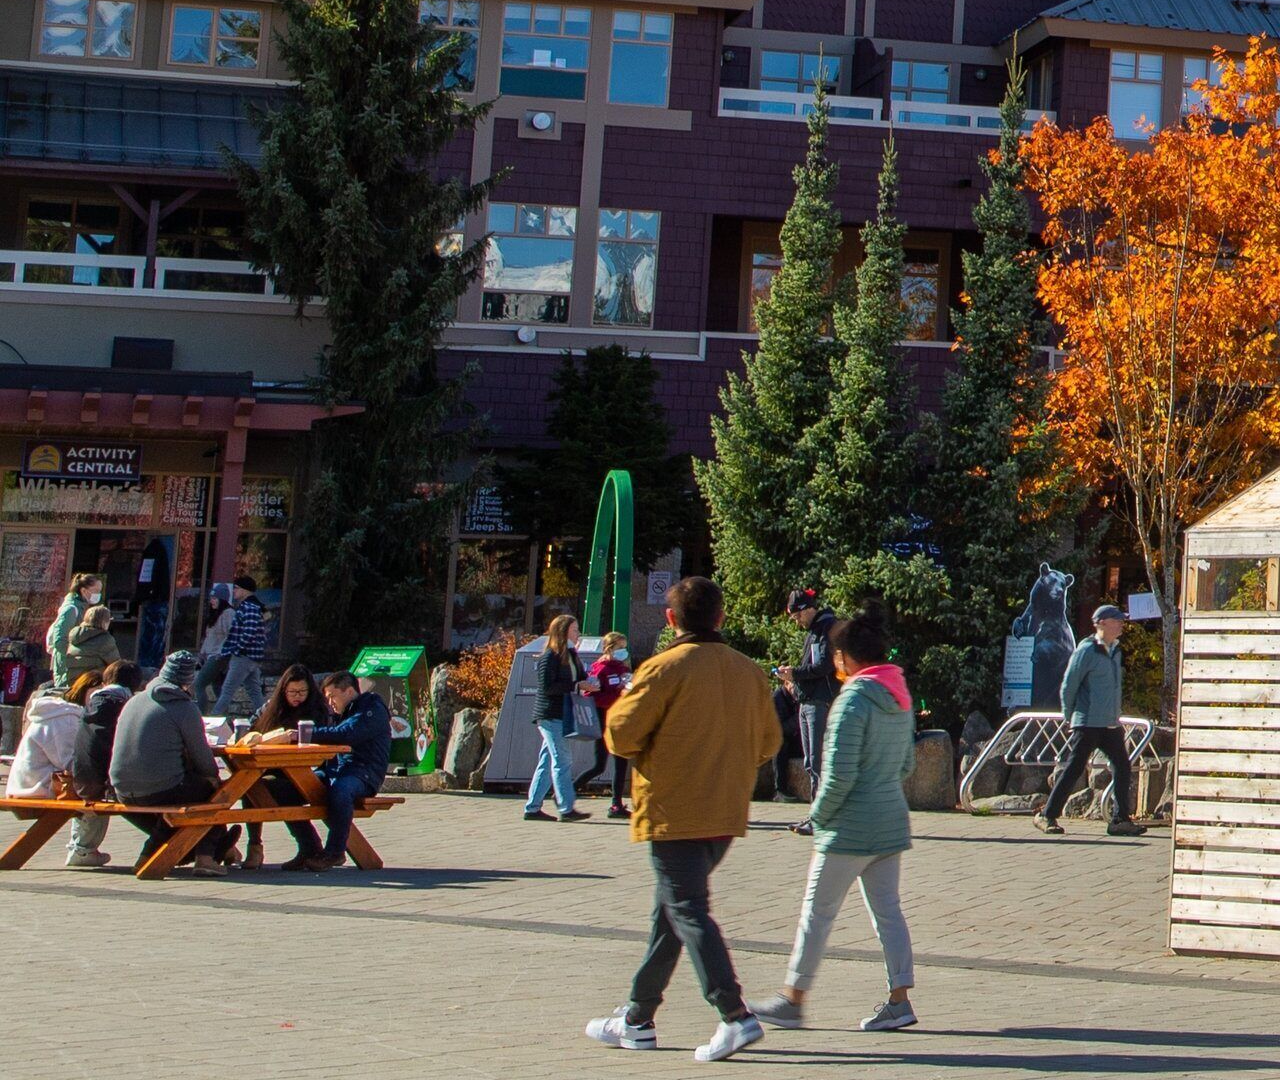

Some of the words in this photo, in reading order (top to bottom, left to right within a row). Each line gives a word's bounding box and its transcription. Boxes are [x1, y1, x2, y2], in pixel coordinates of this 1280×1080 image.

[67, 447, 136, 460] ACTIVITY
[67, 462, 133, 475] CENTRAL
[19, 477, 142, 499] Whistler's
[177, 501, 200, 510] Bear
[163, 515, 204, 526] Canoeing
[470, 522, 495, 532] Jeep
